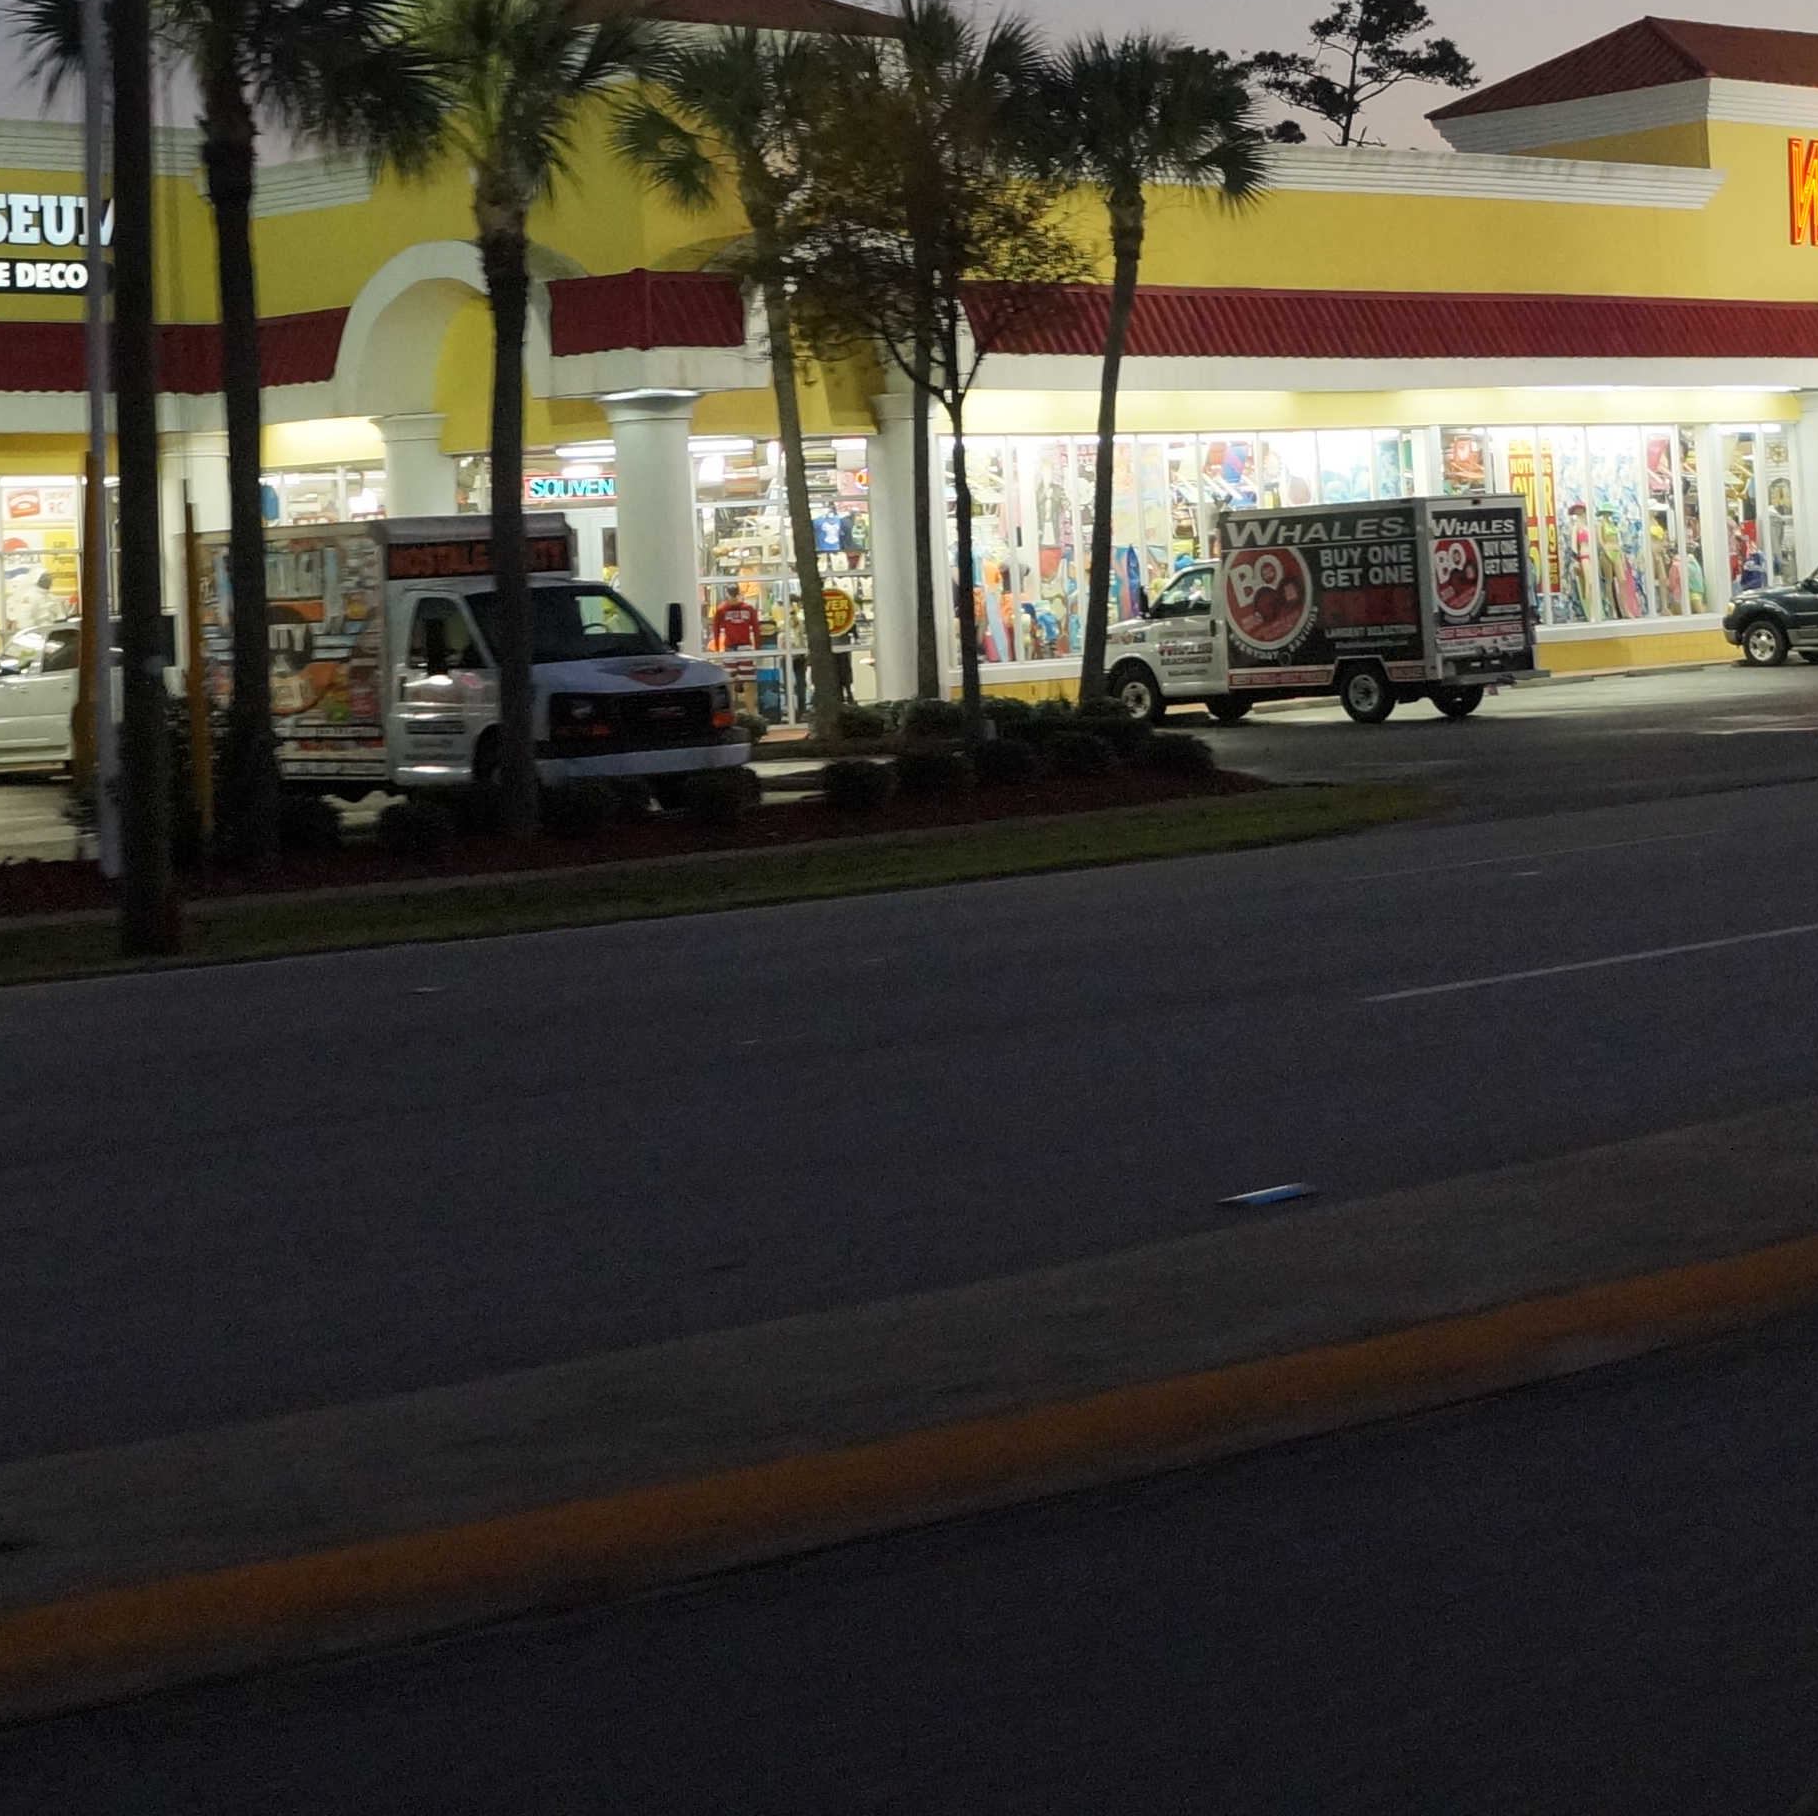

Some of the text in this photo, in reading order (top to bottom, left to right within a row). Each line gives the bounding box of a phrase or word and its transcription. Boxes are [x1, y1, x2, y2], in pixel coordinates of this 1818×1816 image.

[15, 263, 88, 289] DECO
[1510, 457, 1552, 474] NOTHG
[529, 478, 615, 497] SOUVEN
[1511, 476, 1555, 518] OVR
[1225, 516, 1407, 548] WHALES
[1432, 518, 1516, 536] WHALES
[1319, 544, 1412, 568] BUY ONE
[1321, 564, 1414, 588] GET ONE
